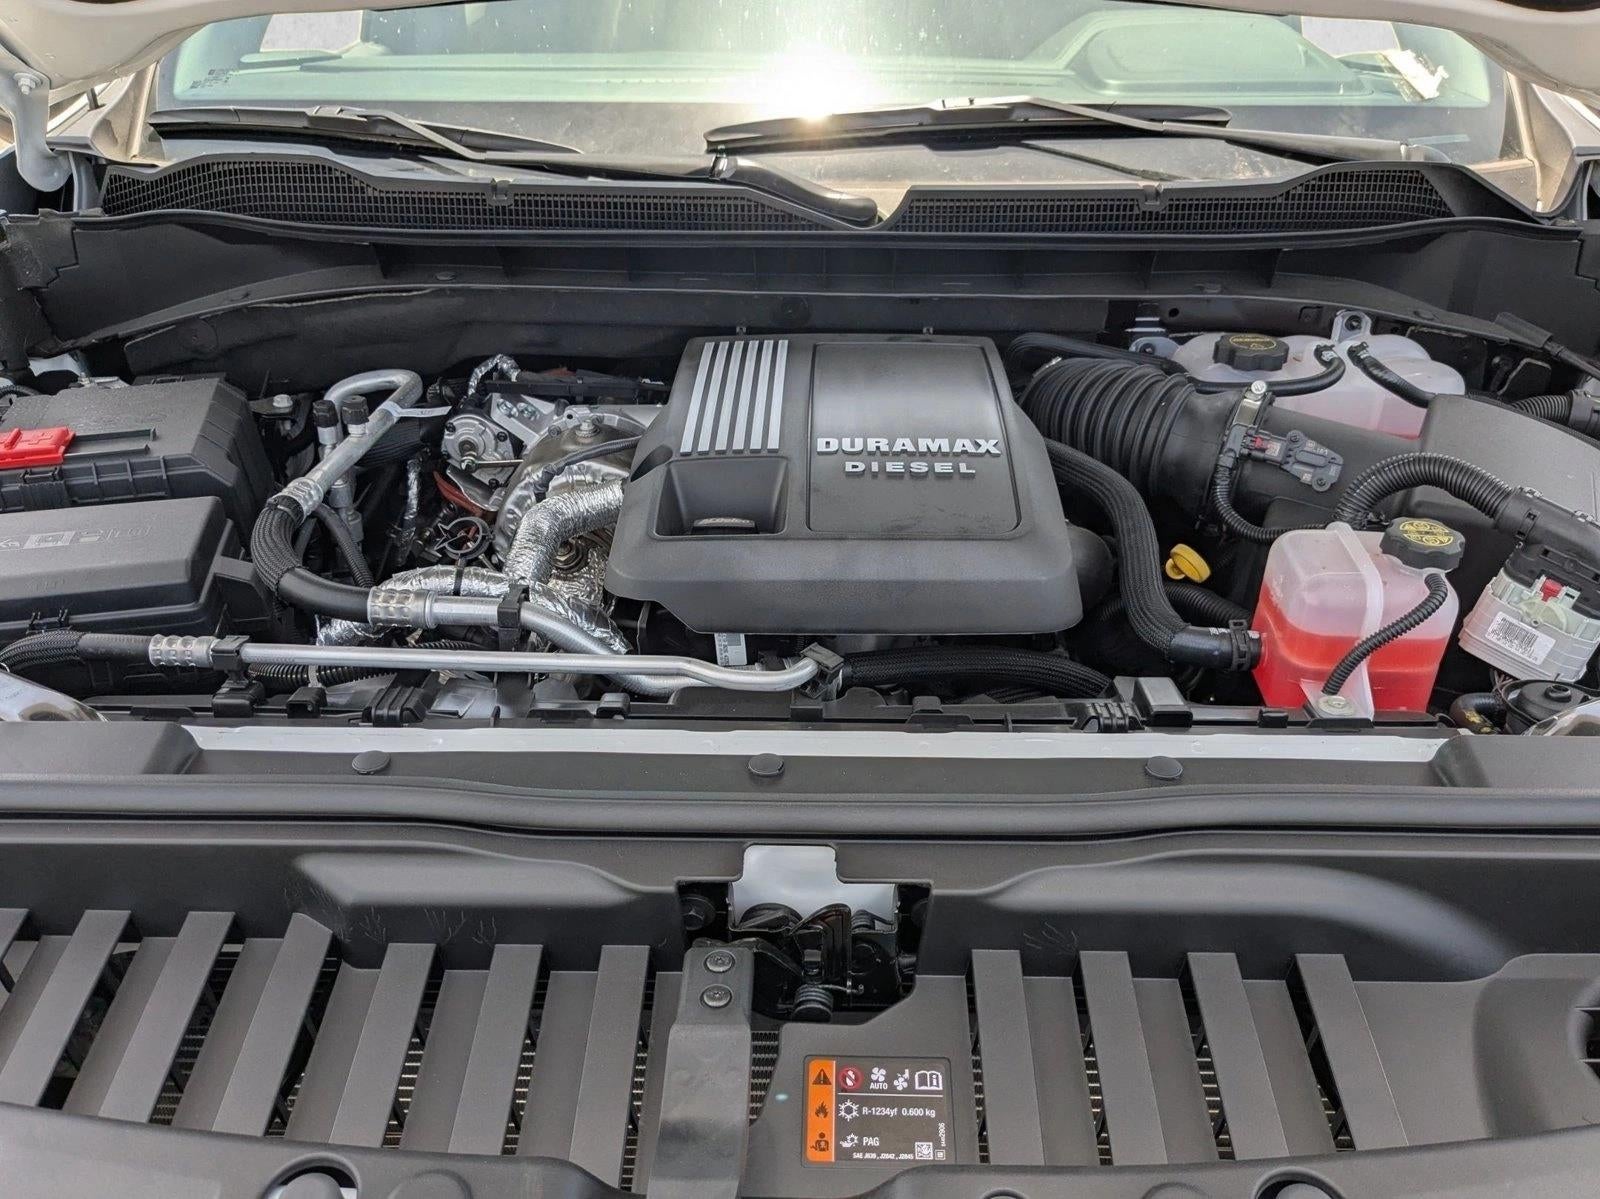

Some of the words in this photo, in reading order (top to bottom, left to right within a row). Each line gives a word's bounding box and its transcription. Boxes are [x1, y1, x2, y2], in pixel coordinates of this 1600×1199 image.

[816, 437, 1001, 455] DURAMAX
[845, 461, 976, 475] DIESEL
[862, 1108, 898, 1118] R-1234yf
[901, 1108, 923, 1116] 0.600
[925, 1108, 936, 1118] kg
[862, 1136, 880, 1146] PAG
